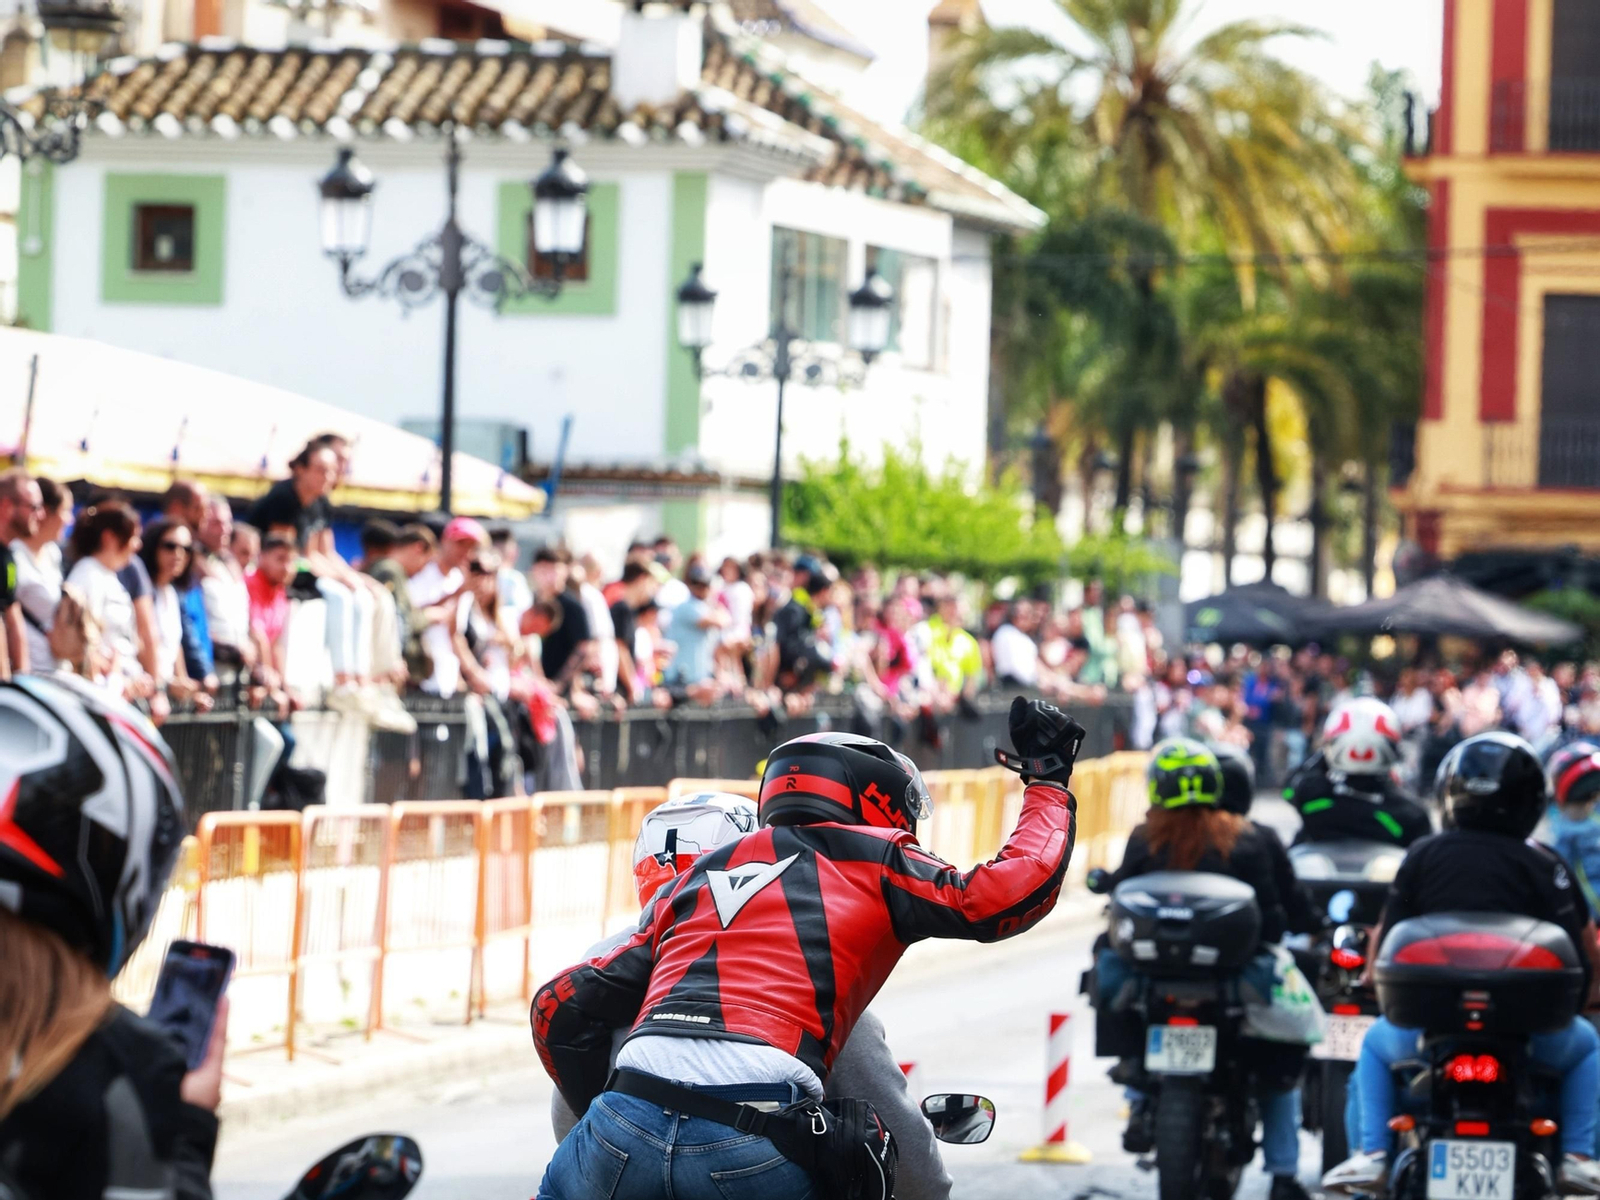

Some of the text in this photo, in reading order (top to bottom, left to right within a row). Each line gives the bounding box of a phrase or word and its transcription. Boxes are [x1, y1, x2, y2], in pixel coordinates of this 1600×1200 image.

[863, 781, 911, 832] HJC
[1450, 1145, 1510, 1172] 5503
[1456, 1173, 1500, 1196] KVK
